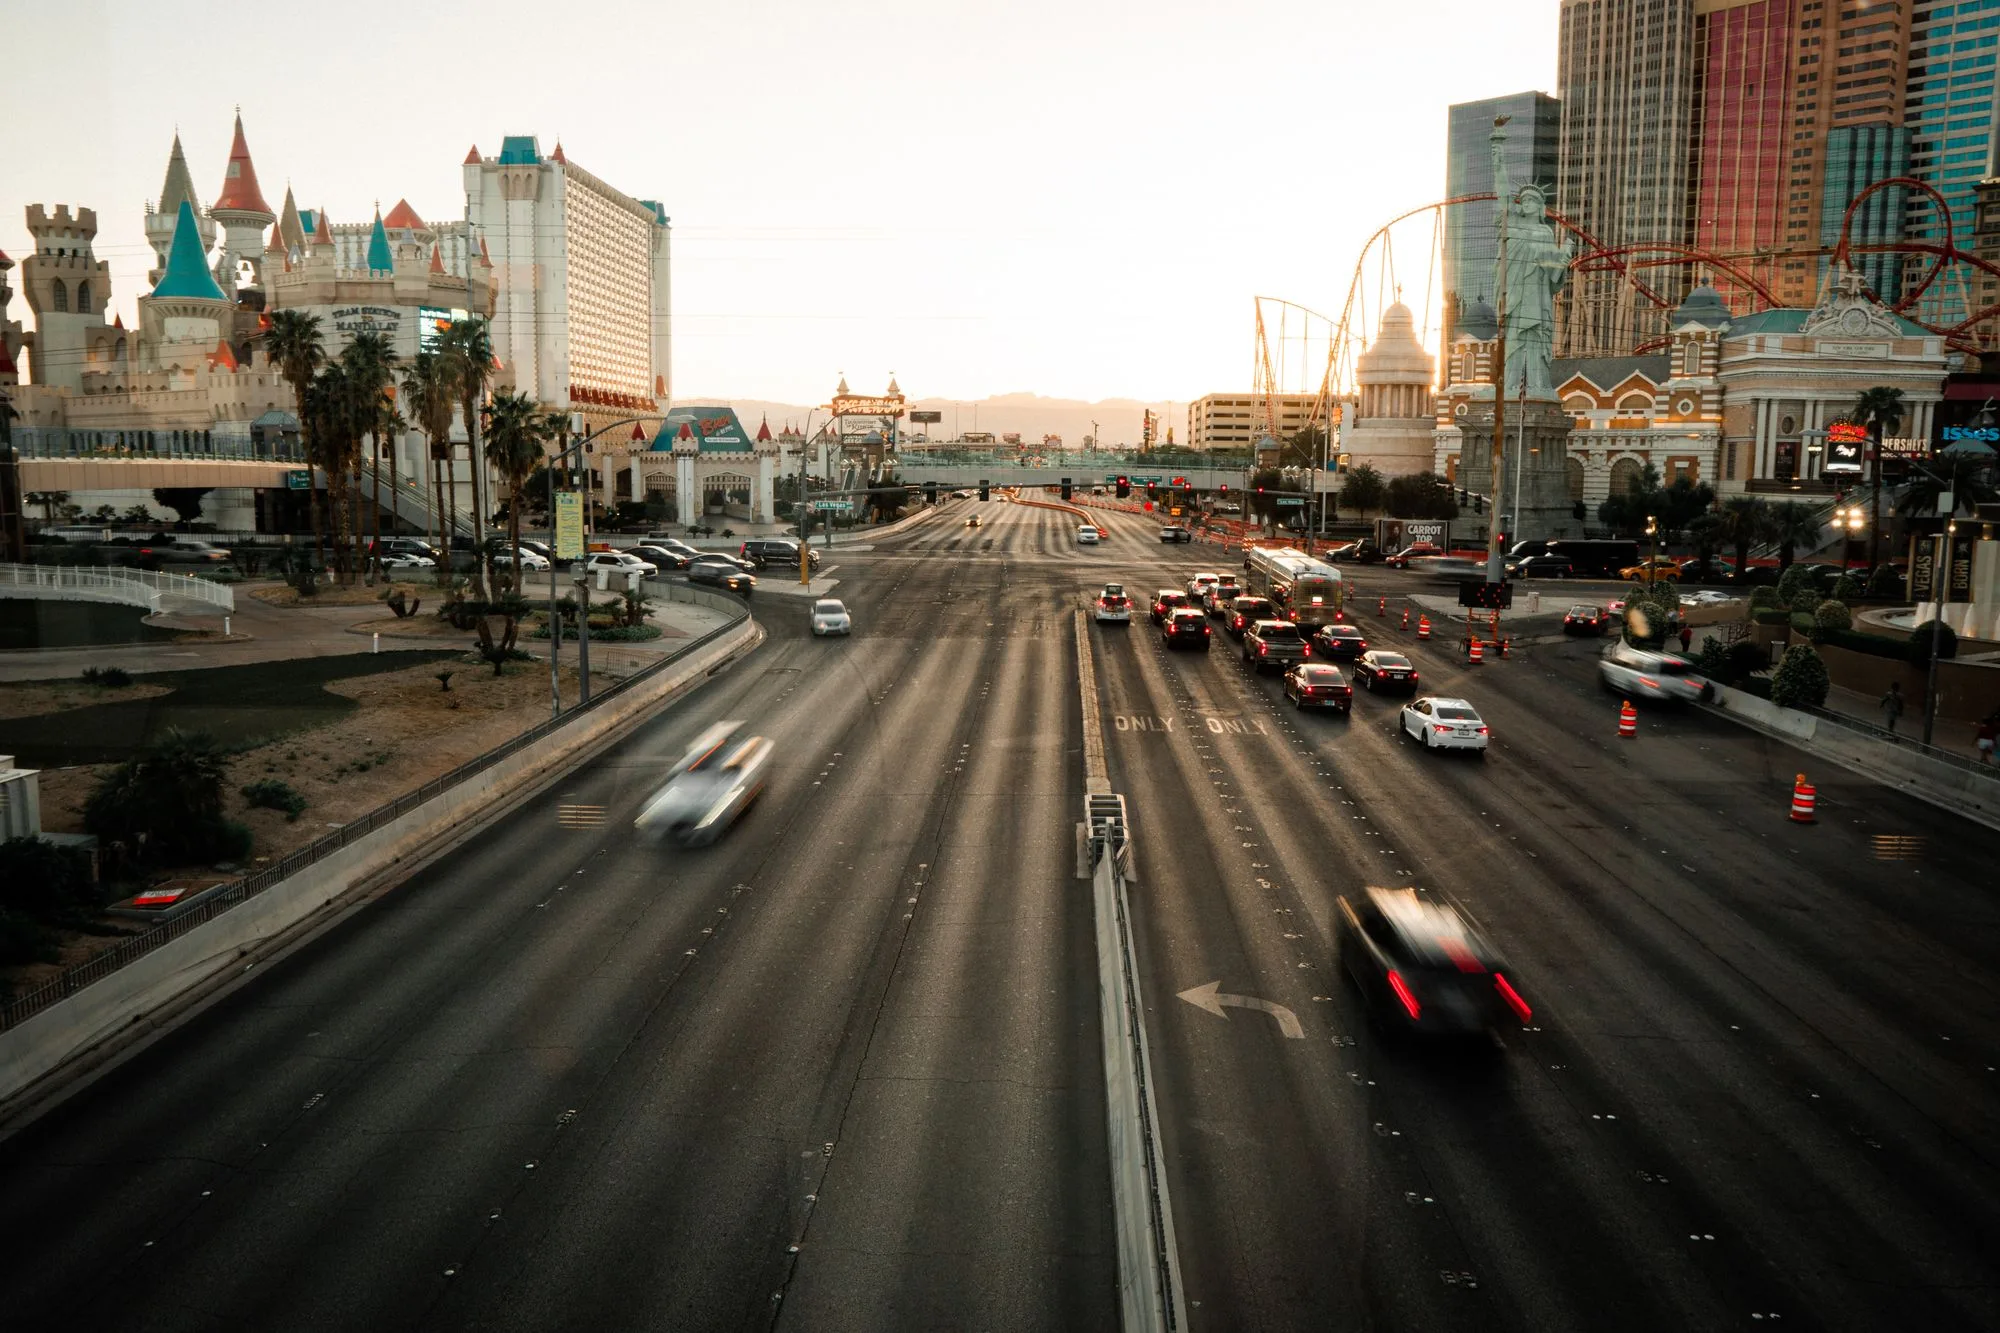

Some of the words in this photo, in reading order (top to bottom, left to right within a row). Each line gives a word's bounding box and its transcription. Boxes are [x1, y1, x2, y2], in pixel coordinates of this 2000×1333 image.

[332, 307, 360, 319] TRAM
[361, 306, 401, 319] STATION
[336, 321, 399, 331] MANDALAY
[1408, 525, 1442, 535] CARROT
[1914, 556, 1932, 592] VEGAS
[1952, 560, 1970, 589] BORN
[1115, 716, 1173, 732] ONLY
[1206, 717, 1268, 736] ONLY
